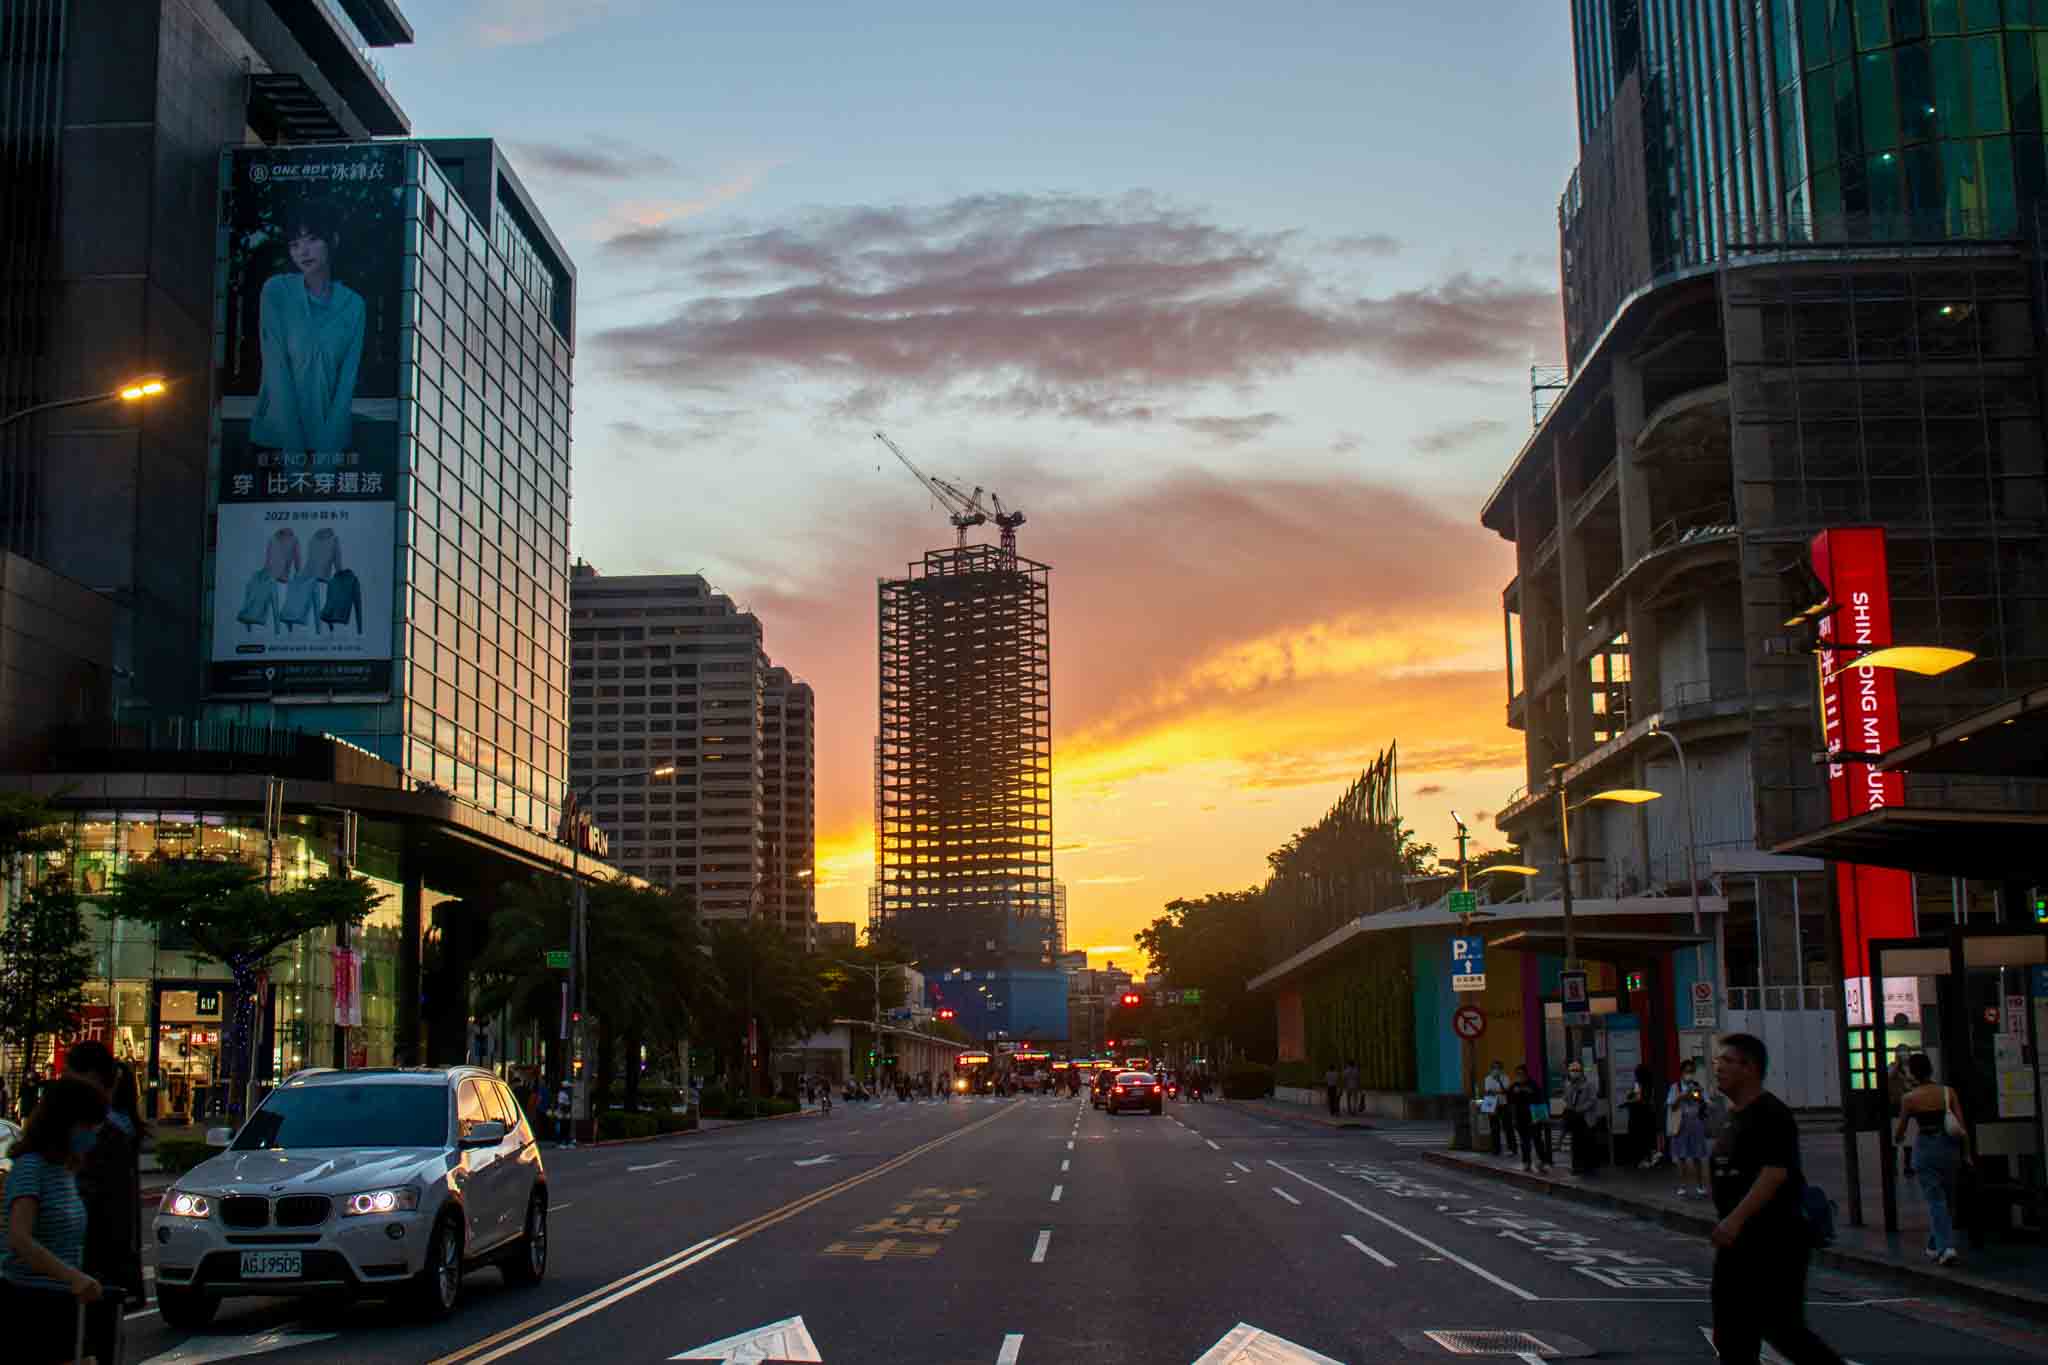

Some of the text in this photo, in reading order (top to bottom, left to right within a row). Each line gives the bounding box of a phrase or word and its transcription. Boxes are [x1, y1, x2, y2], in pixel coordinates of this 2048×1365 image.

[232, 471, 384, 495] 穿 比不穿還涼
[1853, 591, 1873, 645] SHIN
[1858, 649, 1878, 712] ONG
